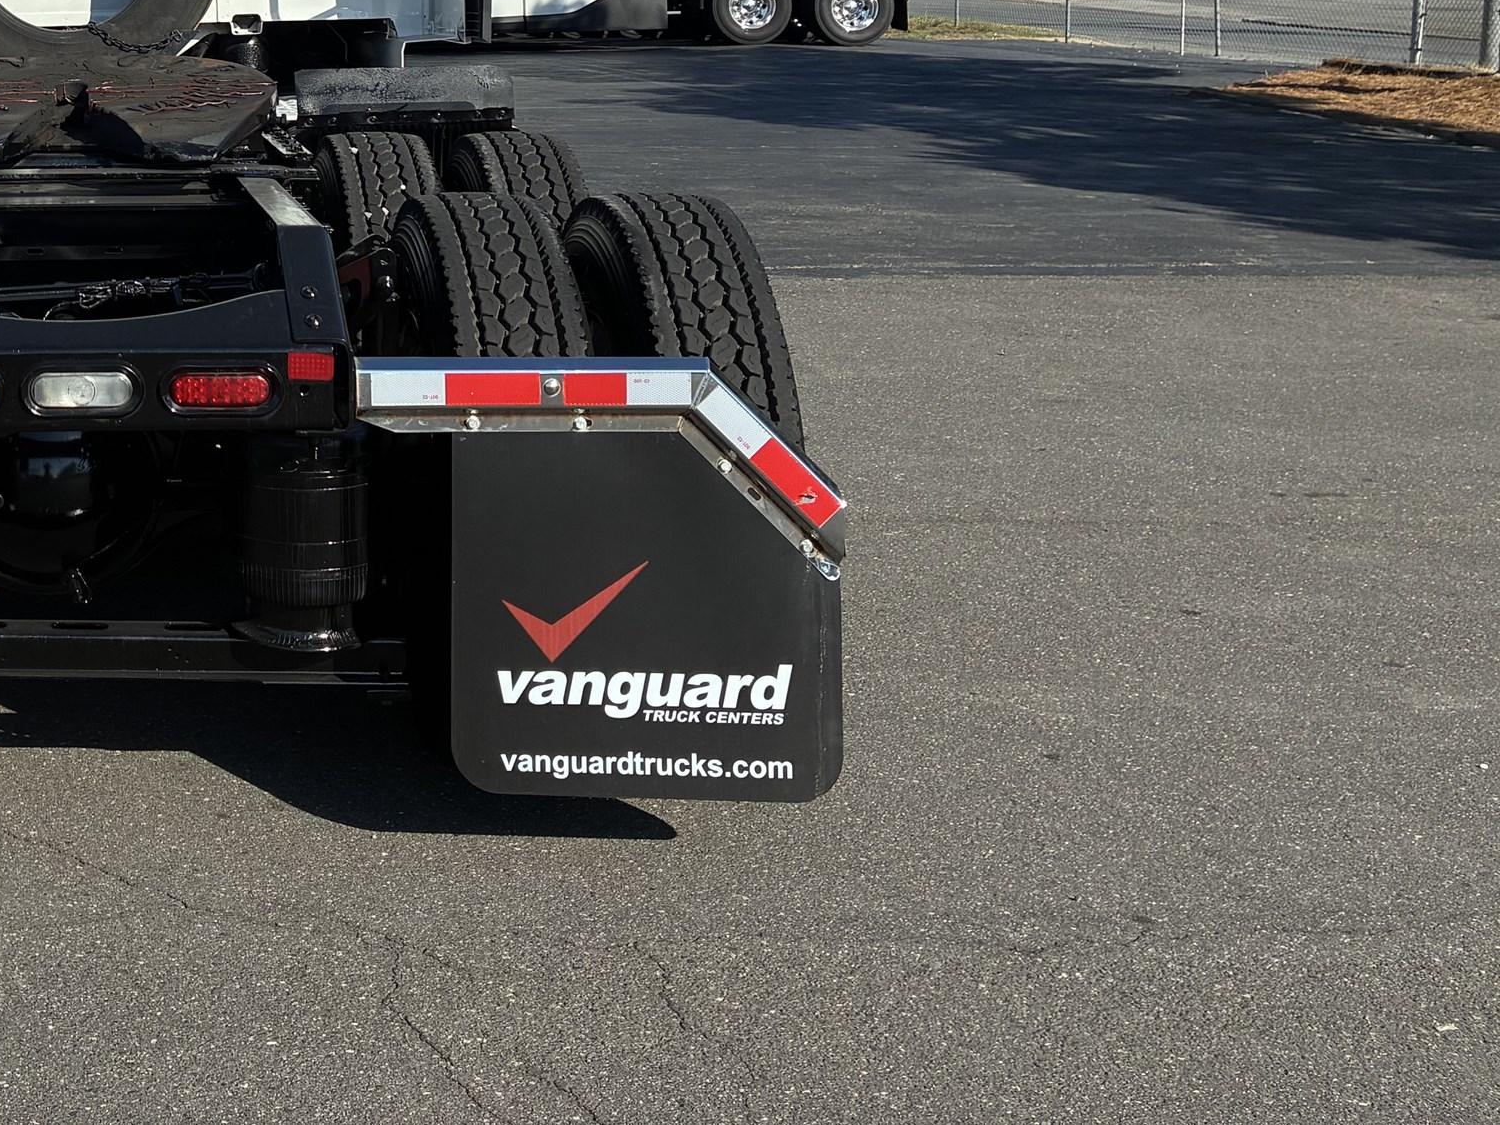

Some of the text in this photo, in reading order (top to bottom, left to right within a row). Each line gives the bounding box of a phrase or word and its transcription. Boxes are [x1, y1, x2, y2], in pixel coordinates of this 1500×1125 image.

[497, 664, 793, 719] vanguard
[643, 709, 785, 725] TRUCK CENTERS
[501, 751, 794, 780] vanguardtrucks.com
